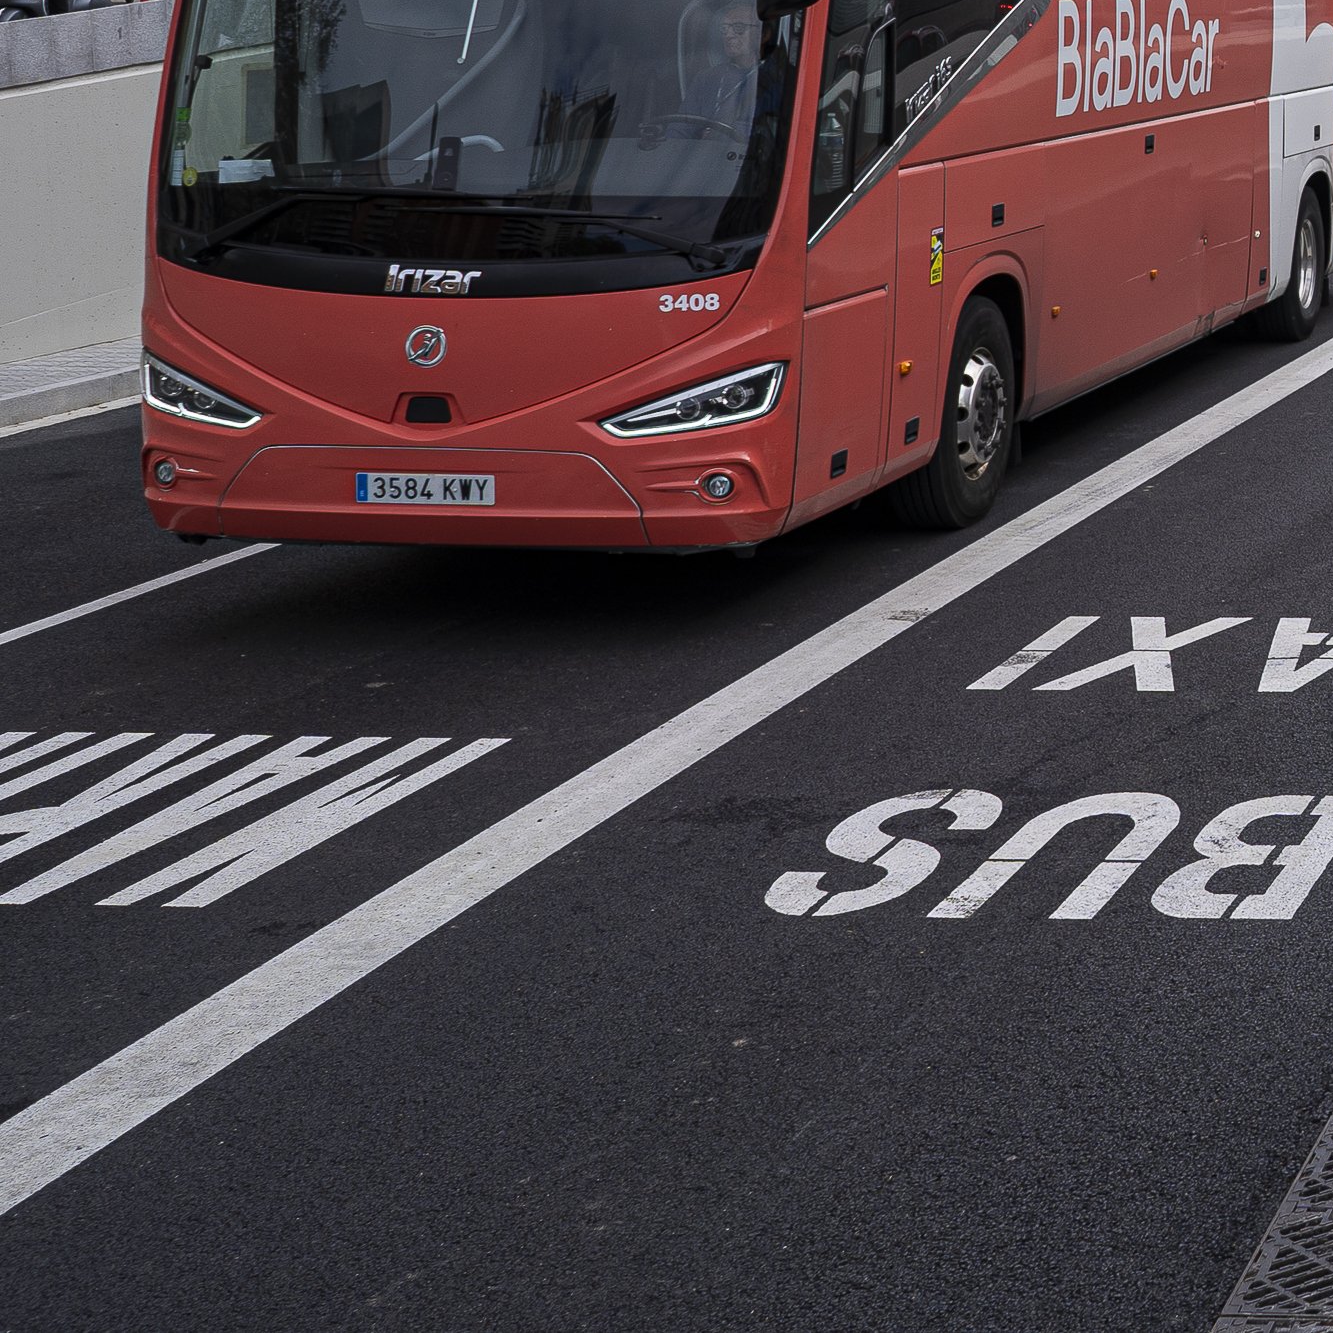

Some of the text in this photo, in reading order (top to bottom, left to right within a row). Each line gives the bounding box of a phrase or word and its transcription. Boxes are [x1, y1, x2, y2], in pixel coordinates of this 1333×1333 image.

[659, 293, 720, 314] 3408
[372, 476, 489, 502] 3584 KWY
